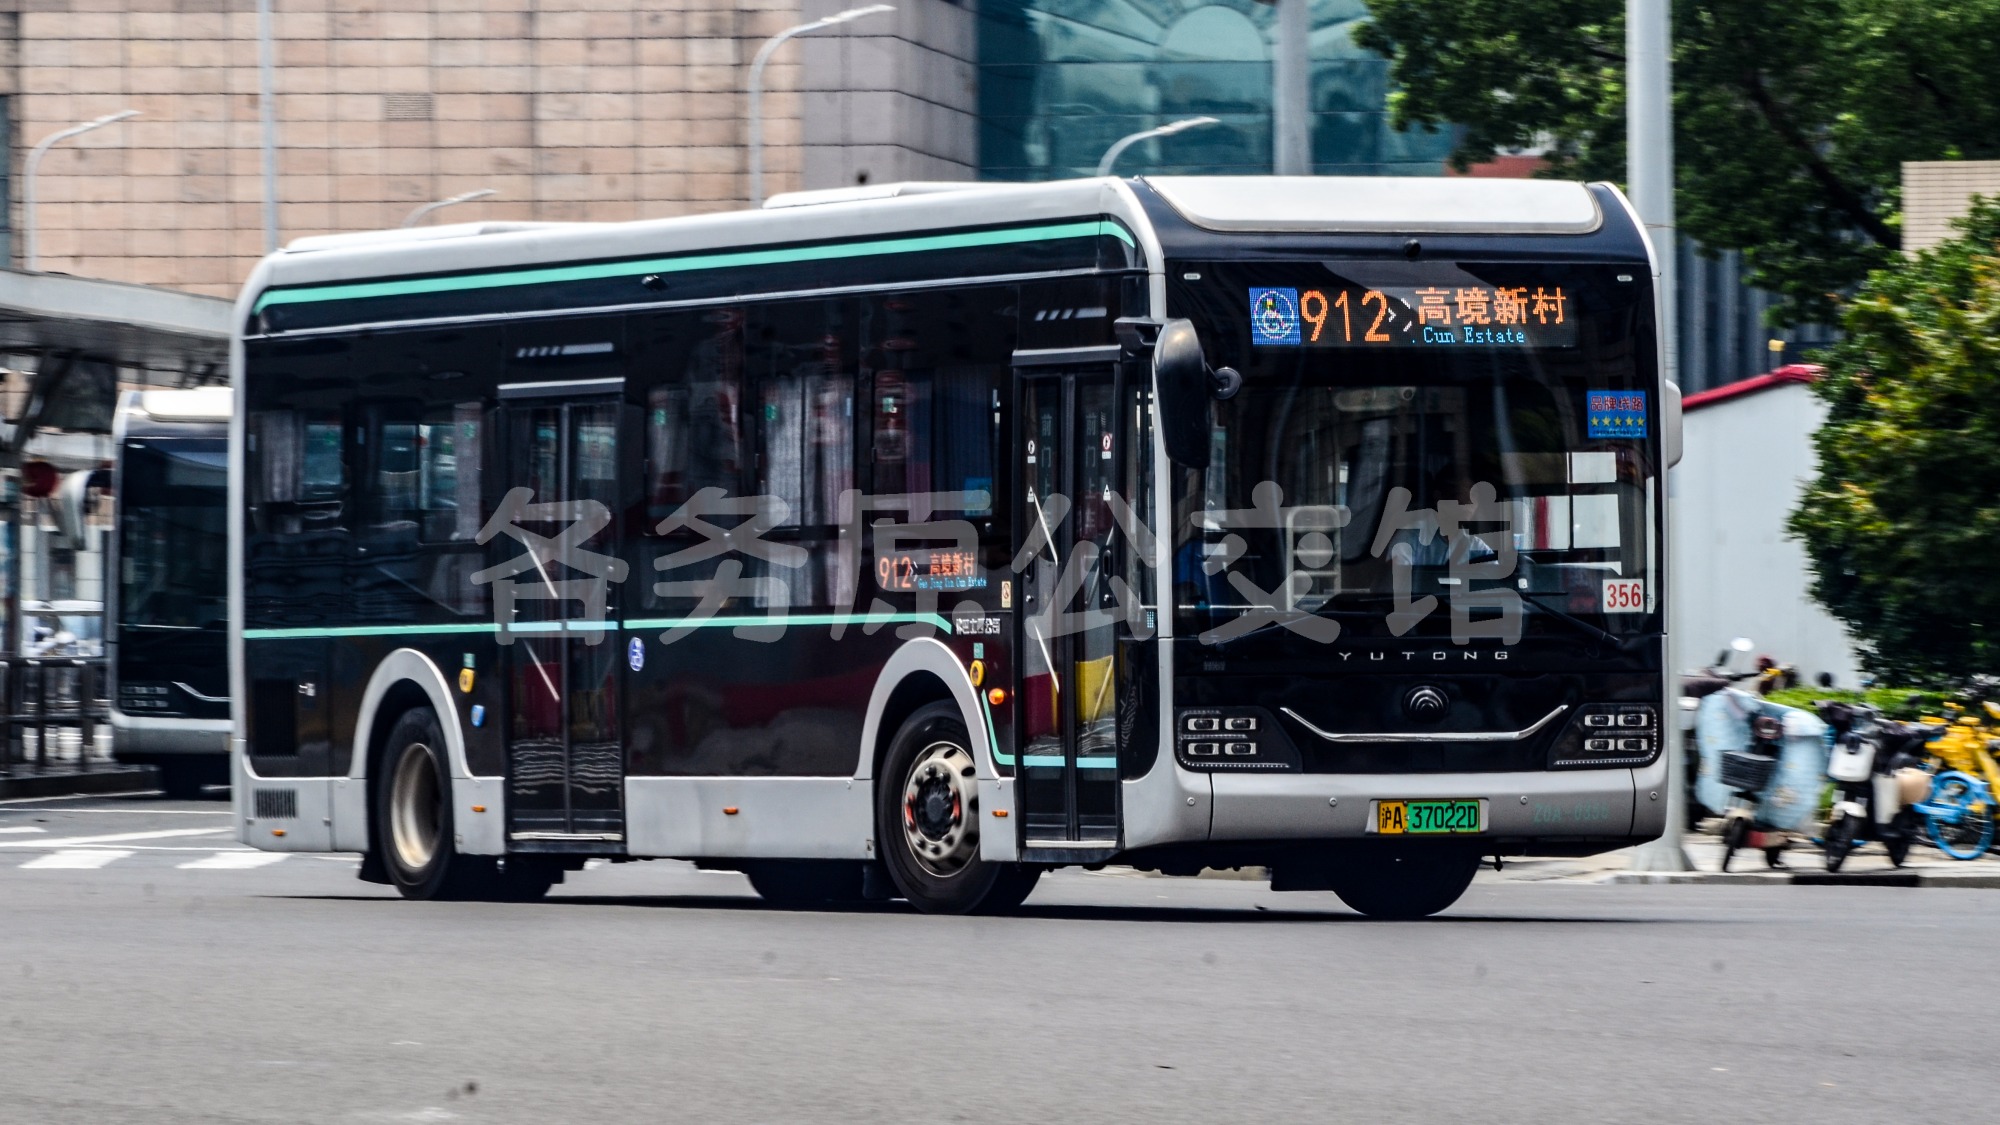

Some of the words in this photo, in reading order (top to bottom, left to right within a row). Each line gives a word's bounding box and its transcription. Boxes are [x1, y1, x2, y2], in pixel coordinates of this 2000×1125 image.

[1300, 289, 1390, 342] 912
[1415, 286, 1567, 325] 高境新村
[1422, 326, 1456, 343] Cun
[1463, 325, 1525, 344] Estate
[1590, 395, 1644, 412] 品牌线路
[879, 556, 913, 589] 912
[929, 552, 975, 577] 高境新村
[1606, 583, 1642, 608] 356
[1338, 651, 1509, 661] YUTONG
